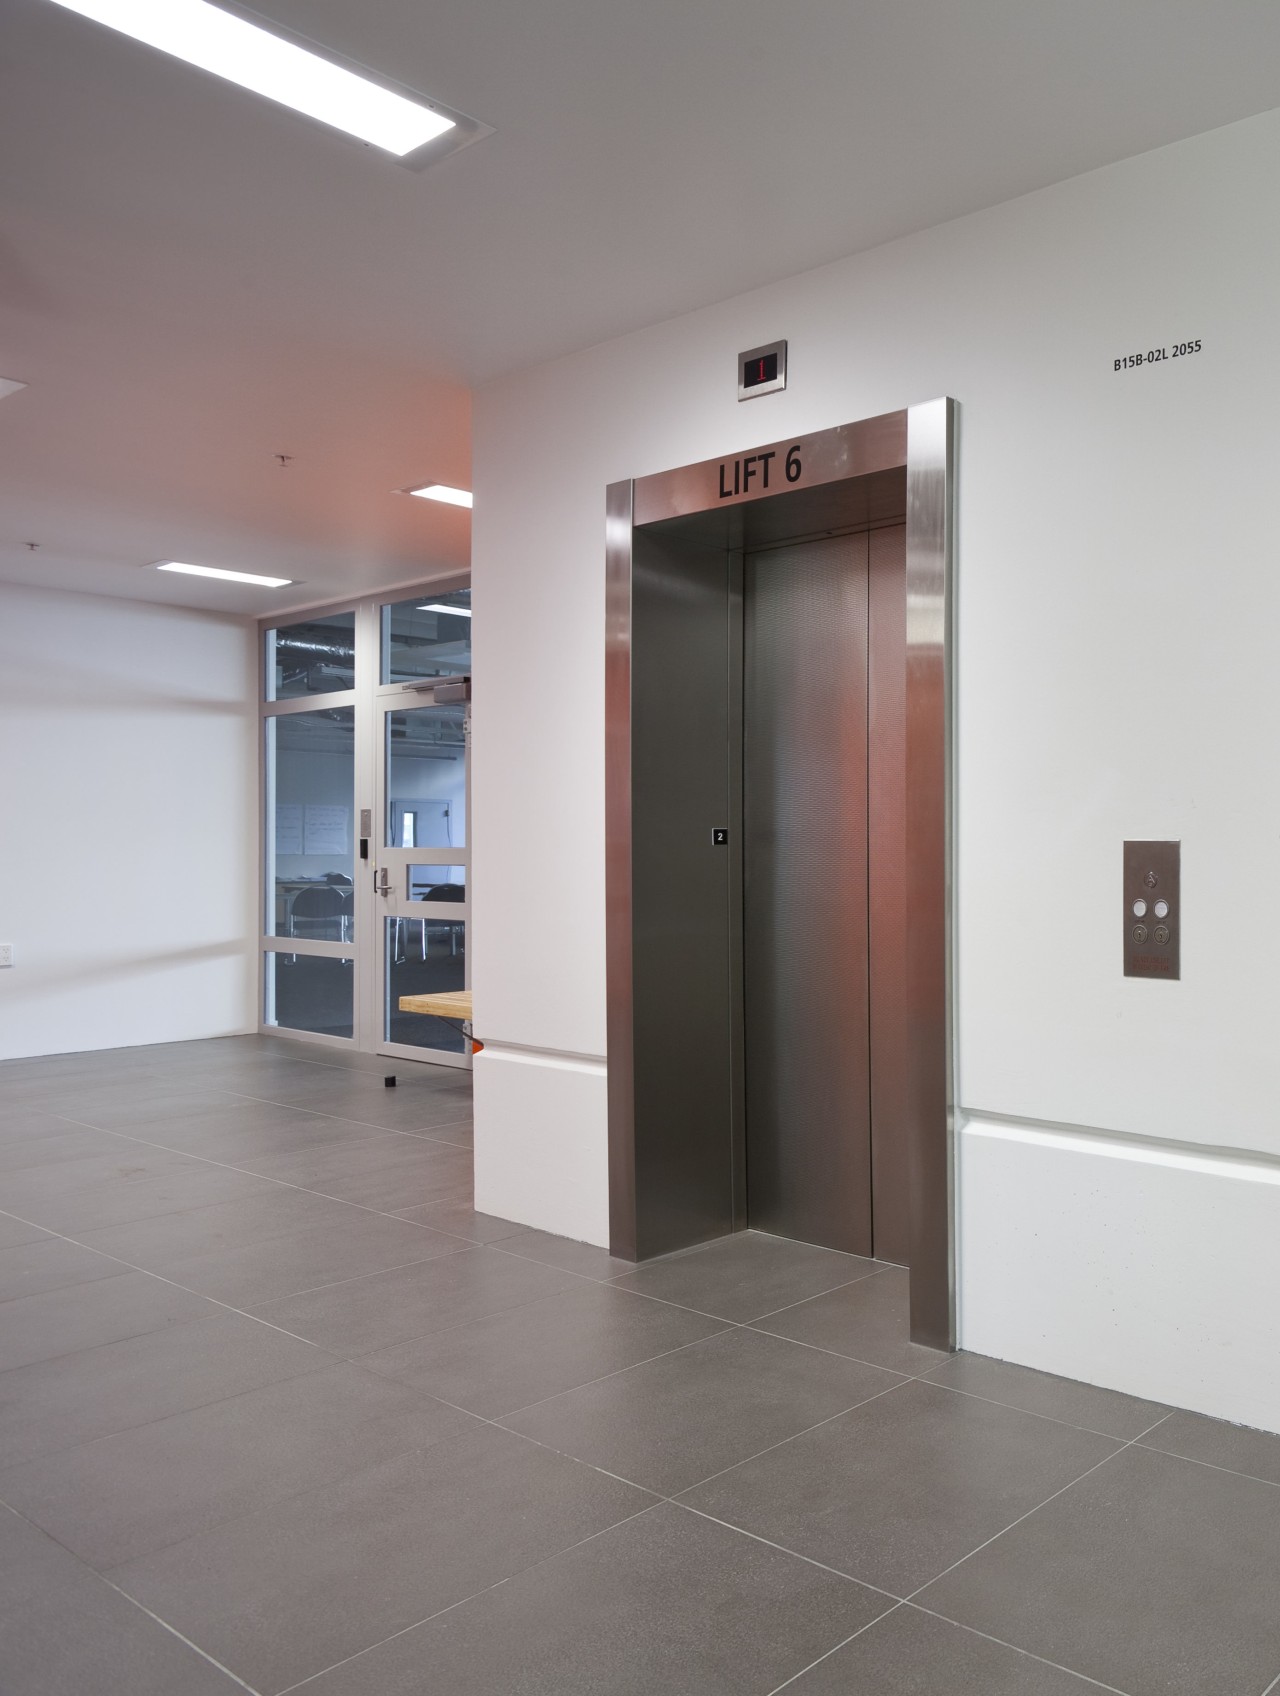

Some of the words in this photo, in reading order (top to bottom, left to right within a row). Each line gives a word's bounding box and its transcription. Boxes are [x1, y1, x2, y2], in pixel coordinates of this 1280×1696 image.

[1113, 348, 1169, 372] B15B-02L
[1172, 339, 1202, 358] 2055
[758, 359, 767, 381] 1
[719, 451, 776, 499] LIFT
[785, 445, 802, 483] 6
[717, 832, 724, 841] 2
